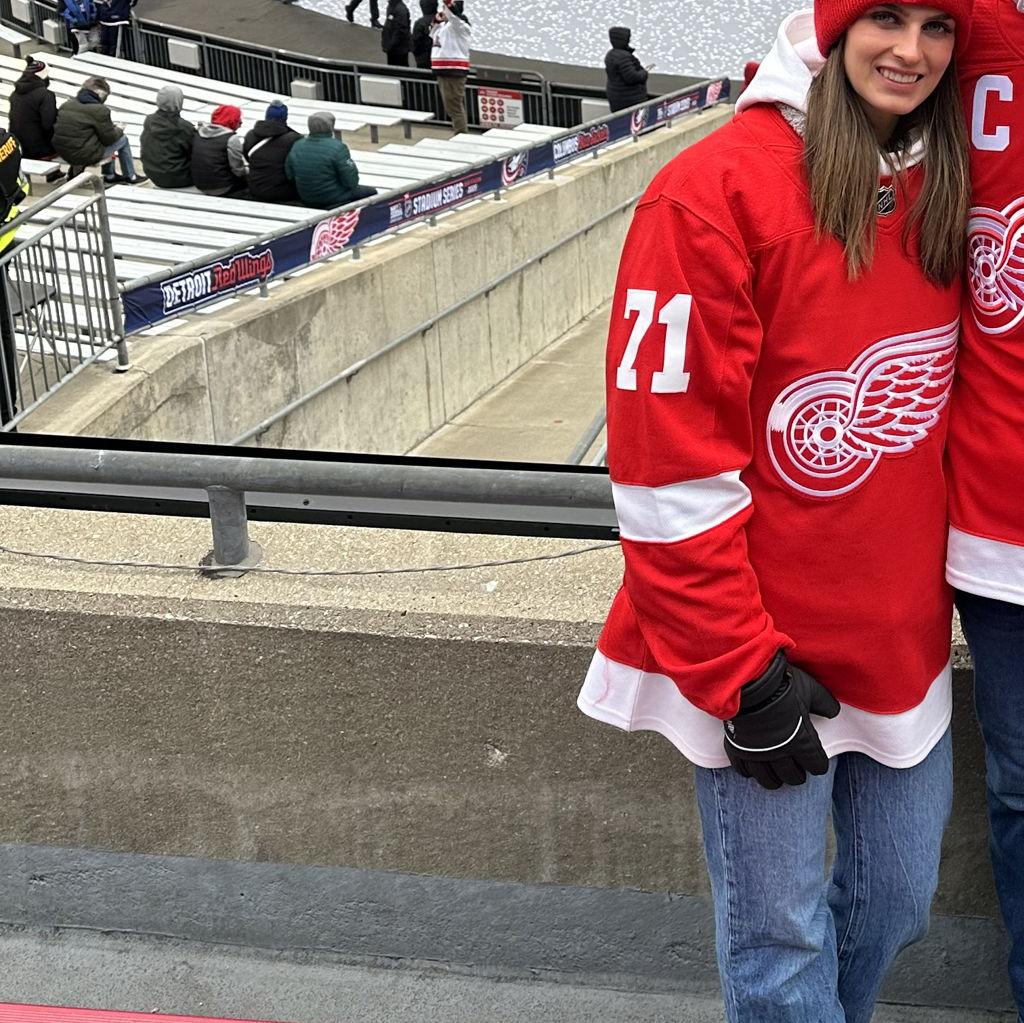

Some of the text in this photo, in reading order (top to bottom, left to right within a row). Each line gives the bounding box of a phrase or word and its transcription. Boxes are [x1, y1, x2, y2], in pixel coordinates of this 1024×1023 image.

[972, 74, 1013, 152] C
[413, 189, 443, 215] STADIUM
[442, 182, 464, 205] SERIES
[163, 270, 211, 308] DETROIT
[616, 288, 692, 394] 71
